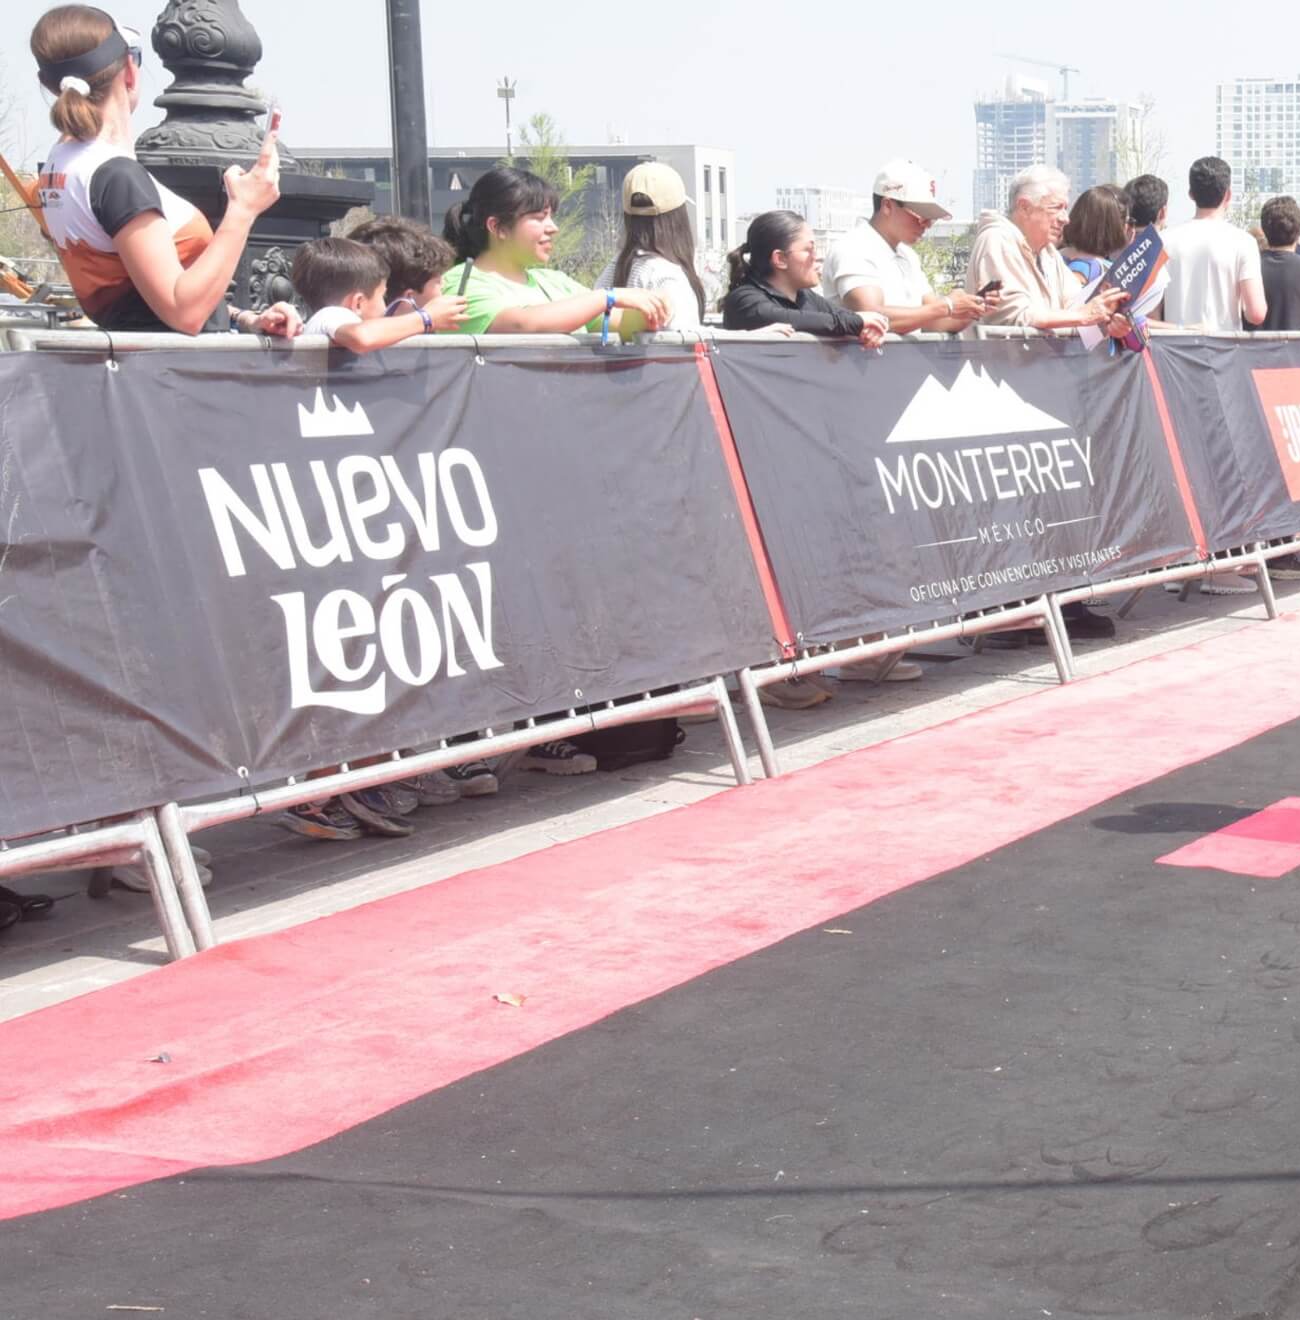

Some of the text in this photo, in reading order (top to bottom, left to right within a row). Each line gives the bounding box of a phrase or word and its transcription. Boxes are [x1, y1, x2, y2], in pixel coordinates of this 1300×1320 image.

[1128, 238, 1152, 265] FALTA
[1121, 259, 1147, 288] POCO!
[874, 436, 1095, 514] MONTERREY
[979, 518, 1045, 545] MÉXICO
[910, 545, 1122, 603] OFICINA DE CONVENCIONES Y VISITANTES
